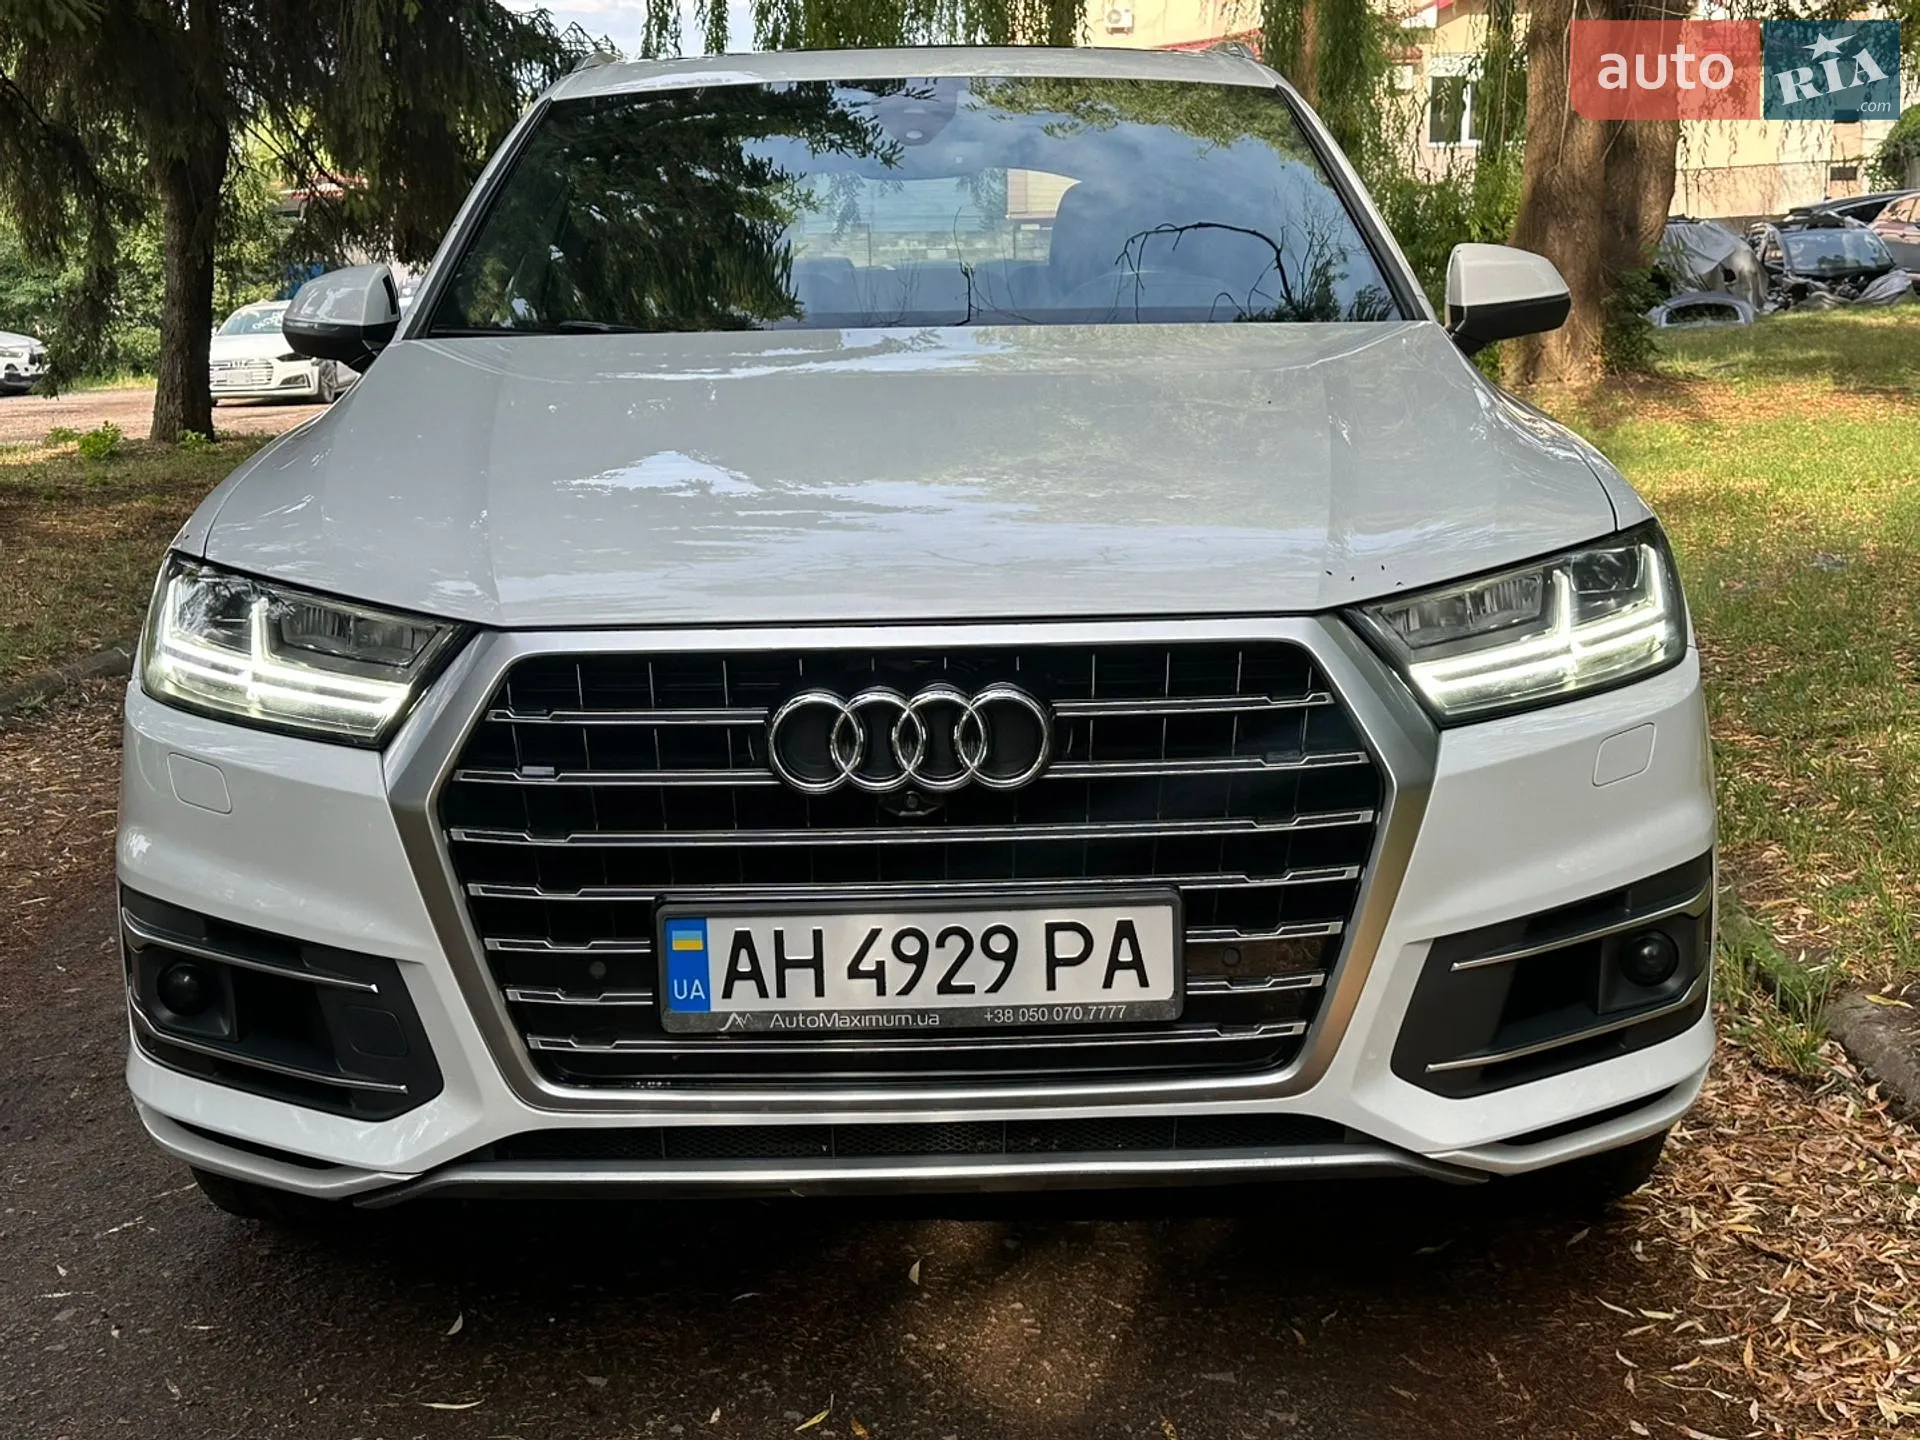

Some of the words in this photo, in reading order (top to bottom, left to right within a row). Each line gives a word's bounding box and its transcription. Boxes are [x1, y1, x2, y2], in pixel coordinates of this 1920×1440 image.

[721, 927, 826, 1000] AH
[846, 923, 1019, 997] 4929
[1044, 918, 1151, 992] PA
[673, 978, 706, 1000] UA
[769, 1012, 941, 1029] AutoMaximum.ua
[984, 1008, 1014, 1023] +38
[1018, 1007, 1048, 1022] 050
[1053, 1006, 1083, 1021] 070
[1088, 1005, 1127, 1020] 7777
